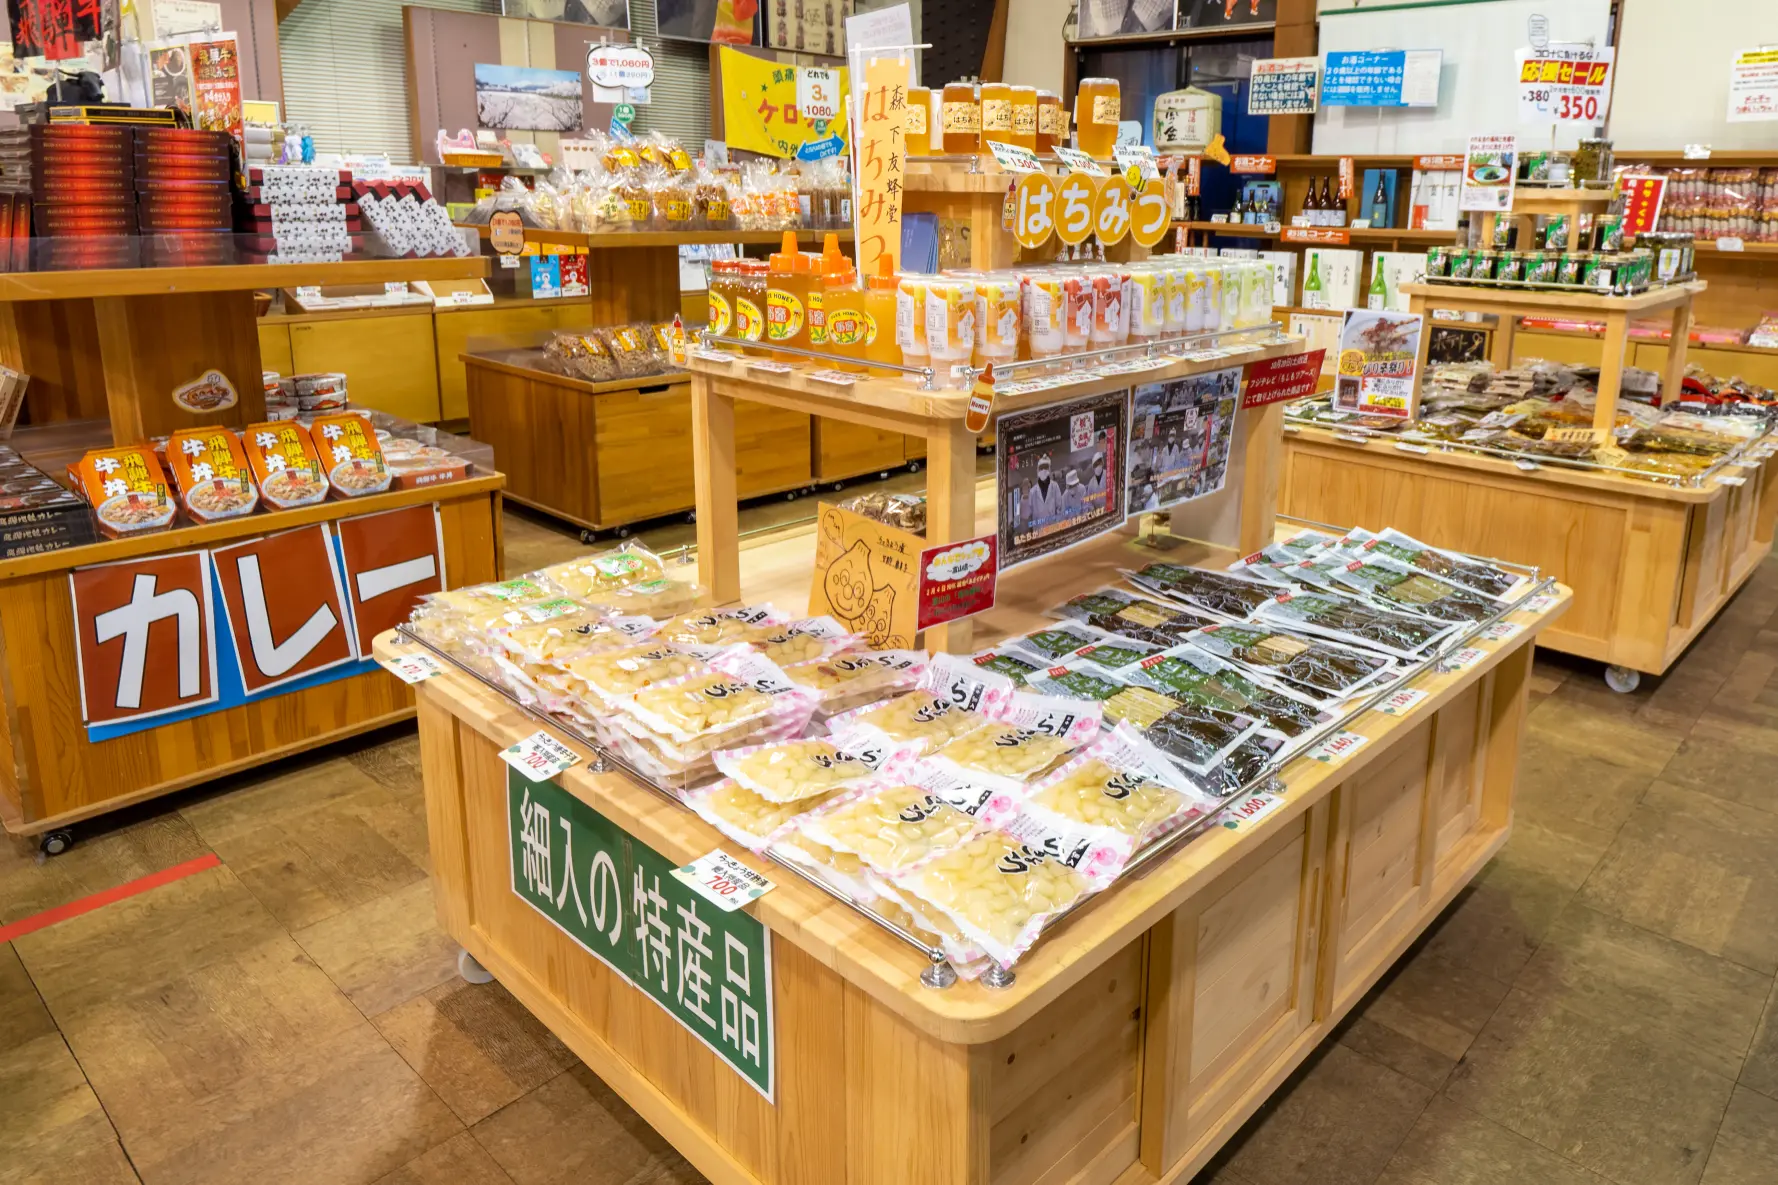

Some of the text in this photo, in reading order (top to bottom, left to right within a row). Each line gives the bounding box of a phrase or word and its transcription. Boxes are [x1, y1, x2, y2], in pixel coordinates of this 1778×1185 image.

[807, 69, 830, 80] どれでも
[1257, 63, 1314, 73] お酒コーナー
[1341, 55, 1389, 65] お酒コーナー
[1520, 61, 1606, 84] 応援セール
[860, 85, 890, 264] はちみつ
[1019, 182, 1166, 235] はちみつ
[773, 292, 795, 305] HONEY
[970, 400, 989, 411] HONEY
[256, 432, 287, 472] 牛丼
[322, 424, 352, 463] 牛丼
[182, 437, 214, 482] 牛丼
[95, 457, 129, 497] 牛丼
[94, 554, 436, 709] カレー
[522, 752, 549, 769] 700
[705, 875, 739, 895] 700
[520, 786, 760, 1069] 細入の特産品
